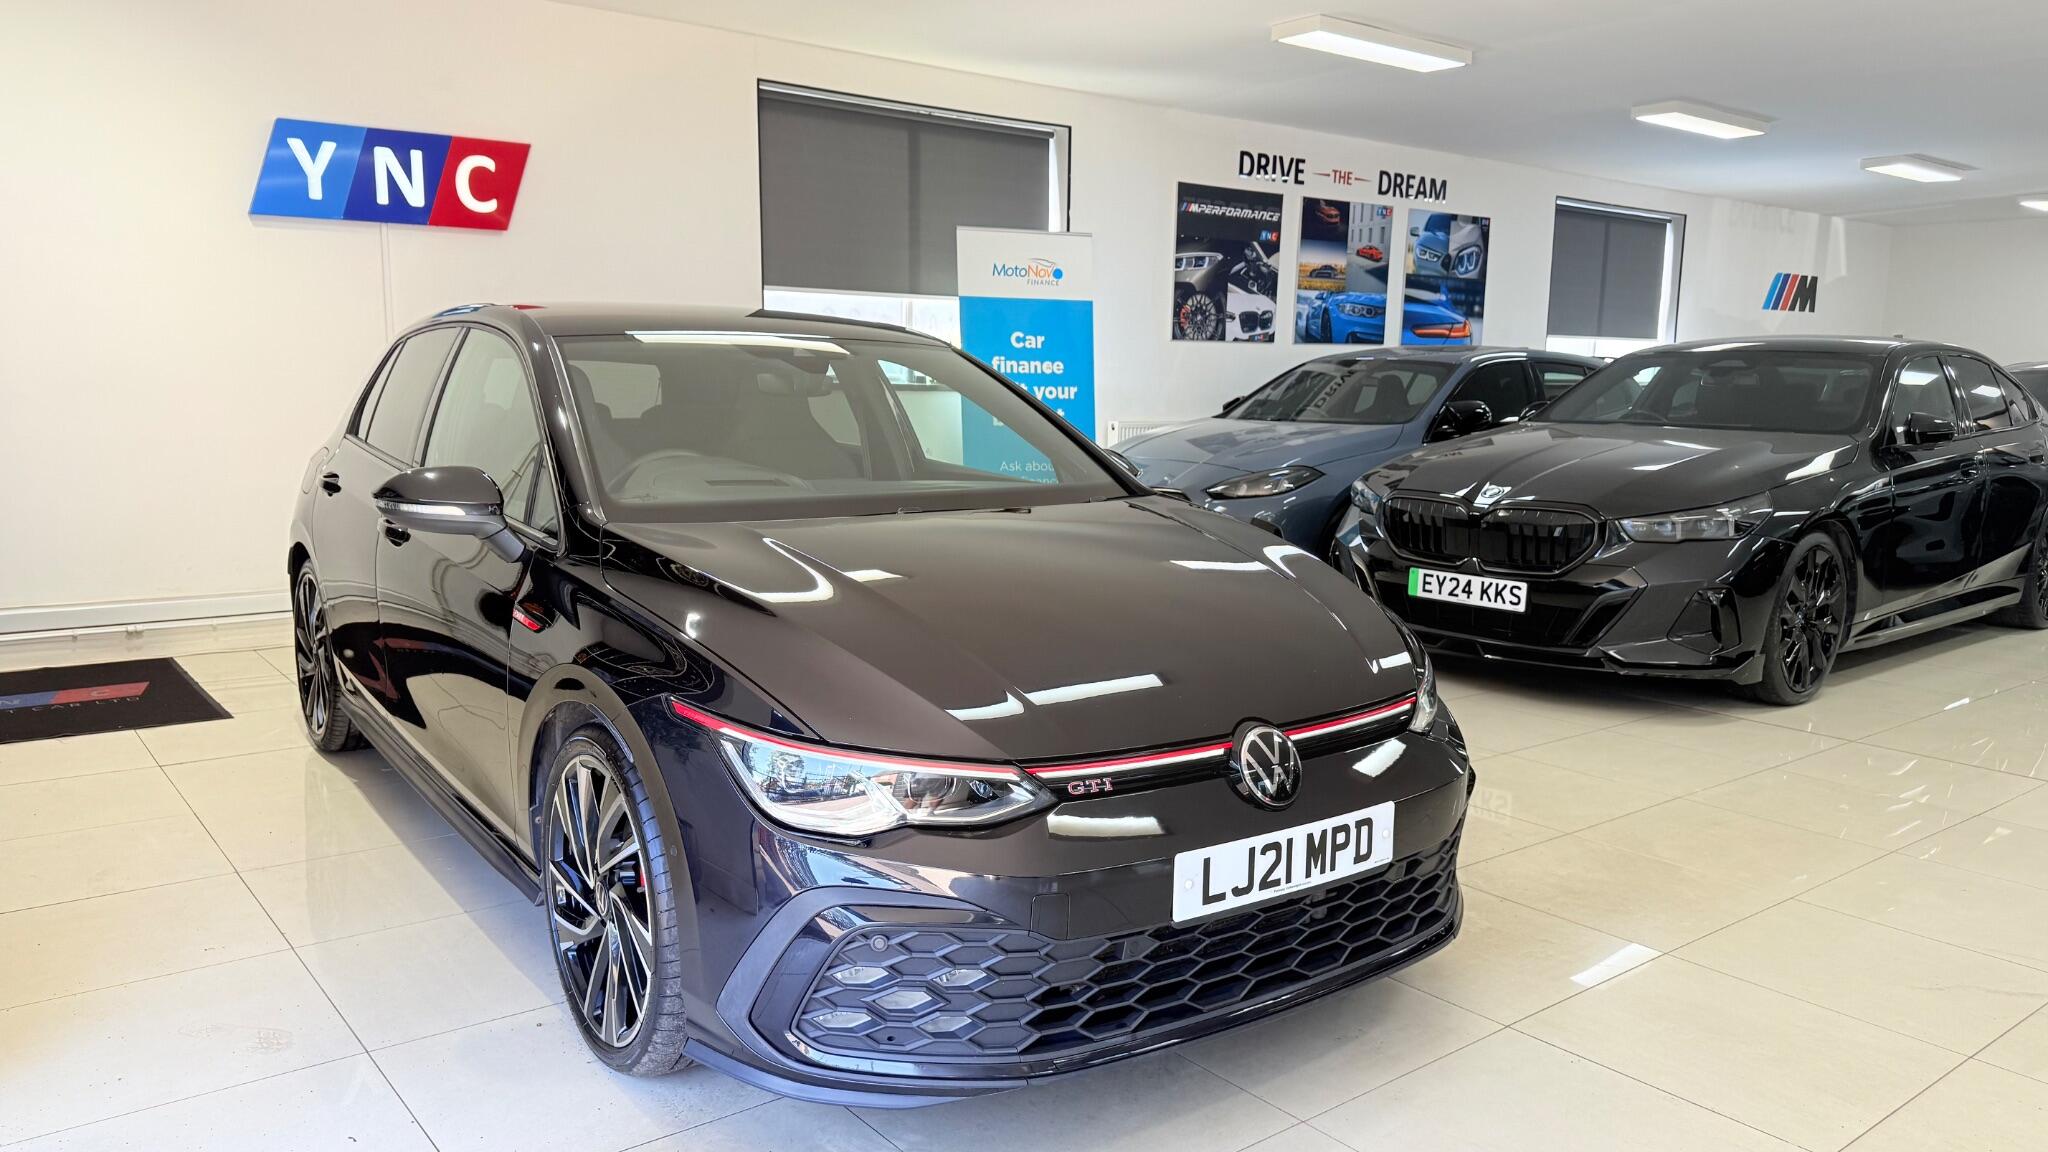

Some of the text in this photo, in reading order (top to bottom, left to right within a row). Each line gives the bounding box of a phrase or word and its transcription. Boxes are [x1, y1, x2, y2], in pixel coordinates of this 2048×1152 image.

[287, 137, 498, 213] YNC
[1238, 150, 1448, 203] DRIVE THE DREAM
[1010, 331, 1045, 349] Car
[992, 356, 1064, 375] finance
[1033, 385, 1078, 400] your
[1000, 460, 1055, 472] Ask abou
[1422, 573, 1522, 606] EY24 KKS
[1067, 777, 1113, 795] GTI
[1202, 817, 1374, 906] LJ21 MPD
